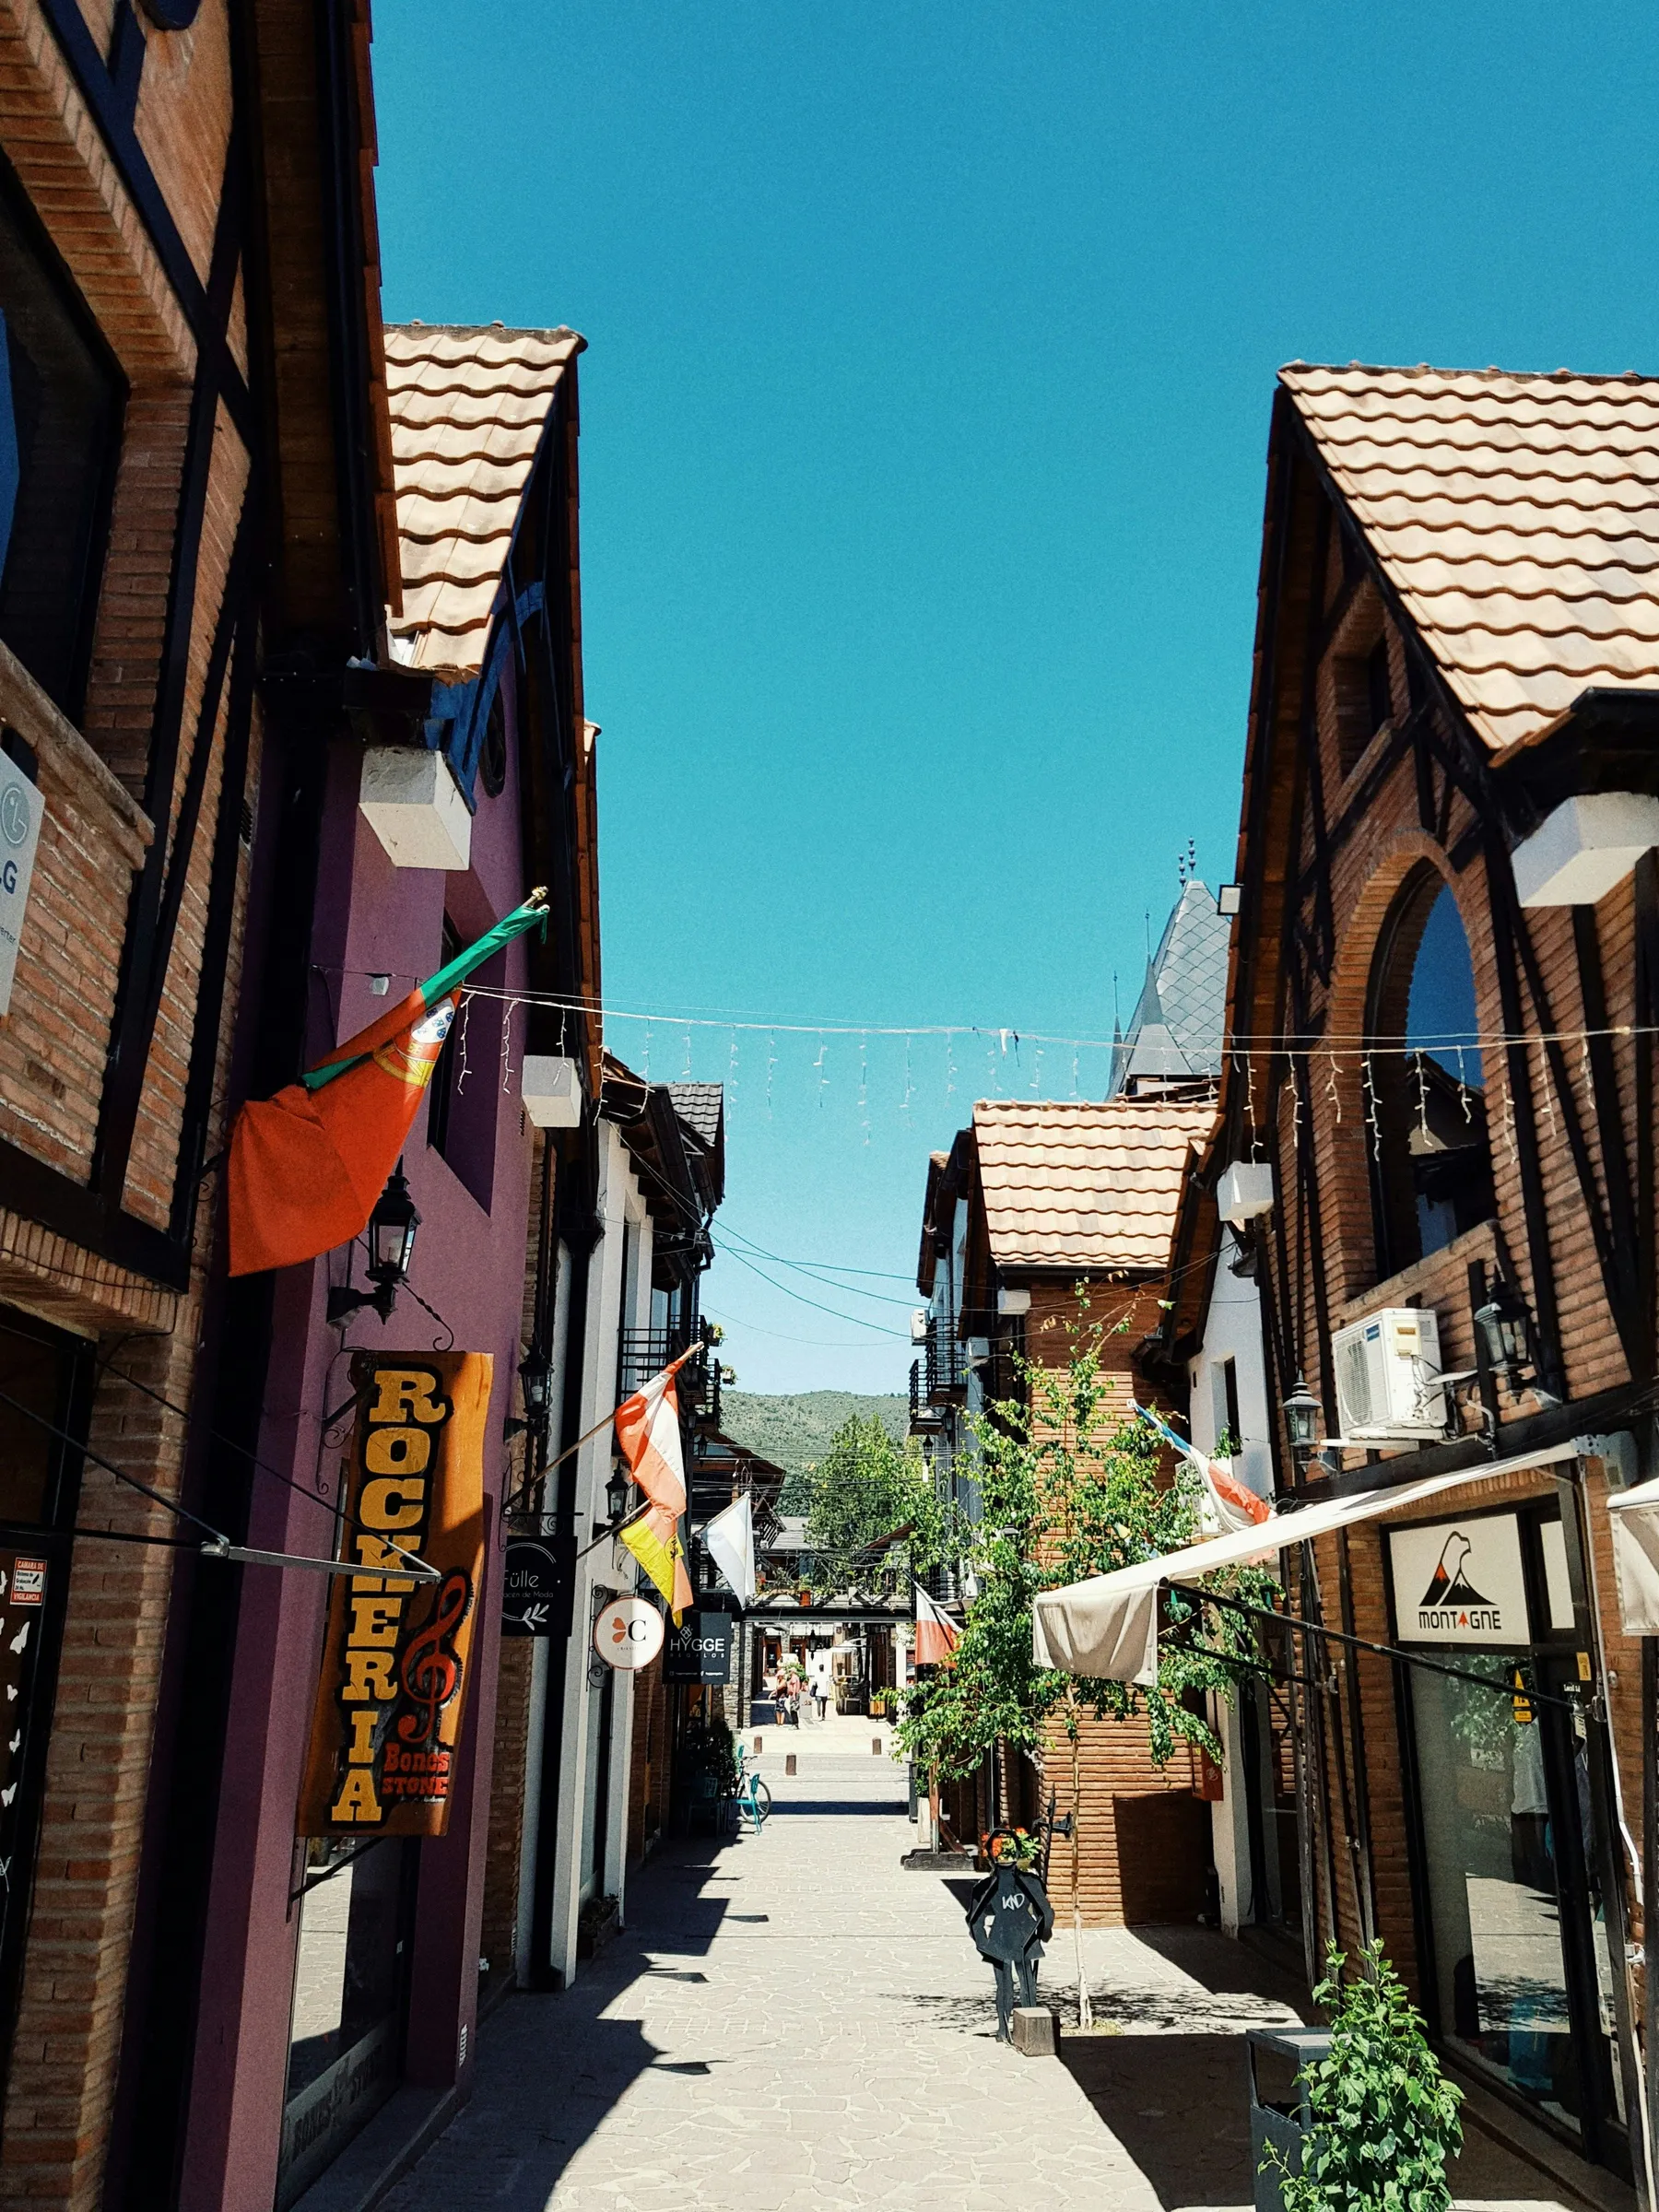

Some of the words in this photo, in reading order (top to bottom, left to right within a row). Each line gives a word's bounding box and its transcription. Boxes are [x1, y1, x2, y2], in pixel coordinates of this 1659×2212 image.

[0, 859, 18, 894] G
[331, 1369, 445, 1823] ROCKERIA
[628, 1619, 646, 1641] C
[1418, 1610, 1502, 1630] MONTAGNE
[670, 1638, 725, 1652] HYGGE
[383, 1743, 450, 1772] Bones
[382, 1777, 449, 1795] STONE
